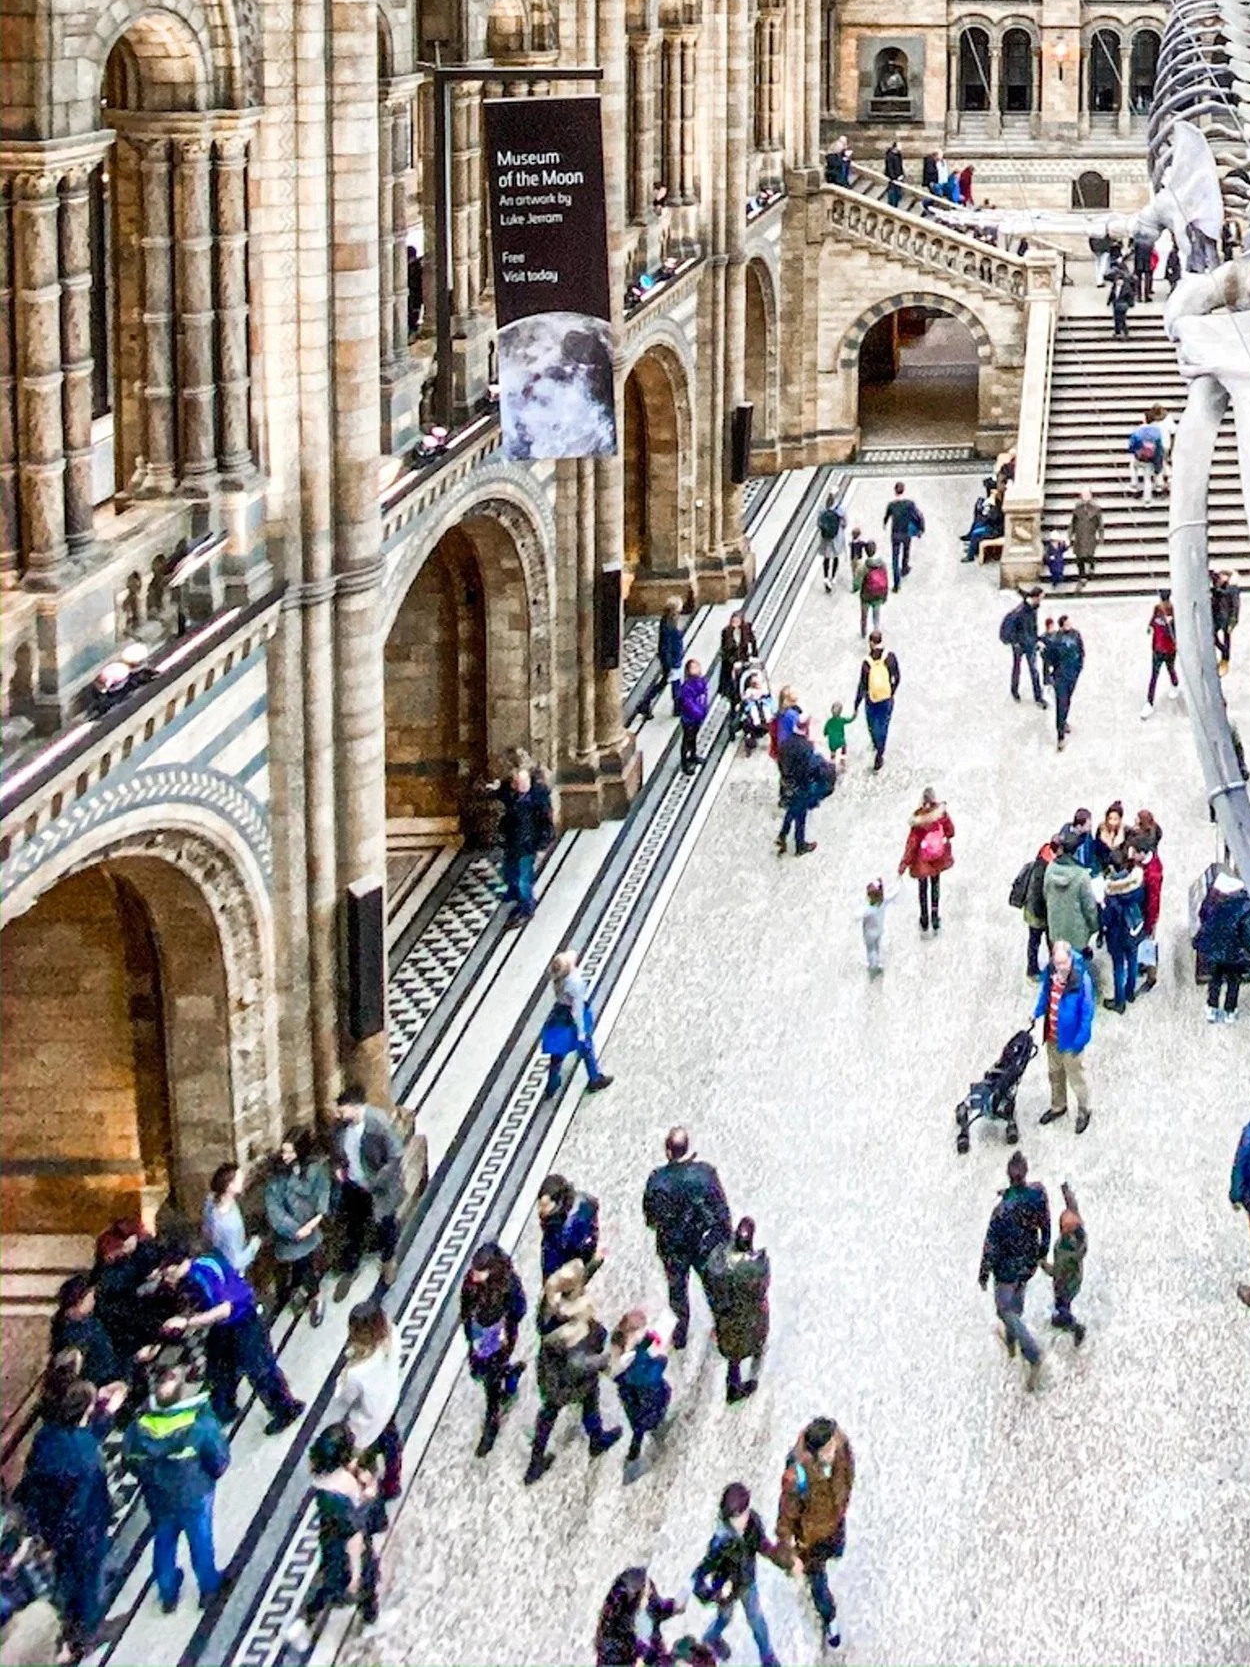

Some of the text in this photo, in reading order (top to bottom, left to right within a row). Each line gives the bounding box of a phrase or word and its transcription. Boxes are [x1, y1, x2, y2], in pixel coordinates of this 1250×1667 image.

[497, 150, 560, 166] Museum
[498, 169, 584, 188] of the Moon
[499, 192, 572, 207] An artwork by
[500, 212, 563, 226] Luke Jerram
[502, 251, 525, 264] Free
[502, 269, 558, 283] Visit today
